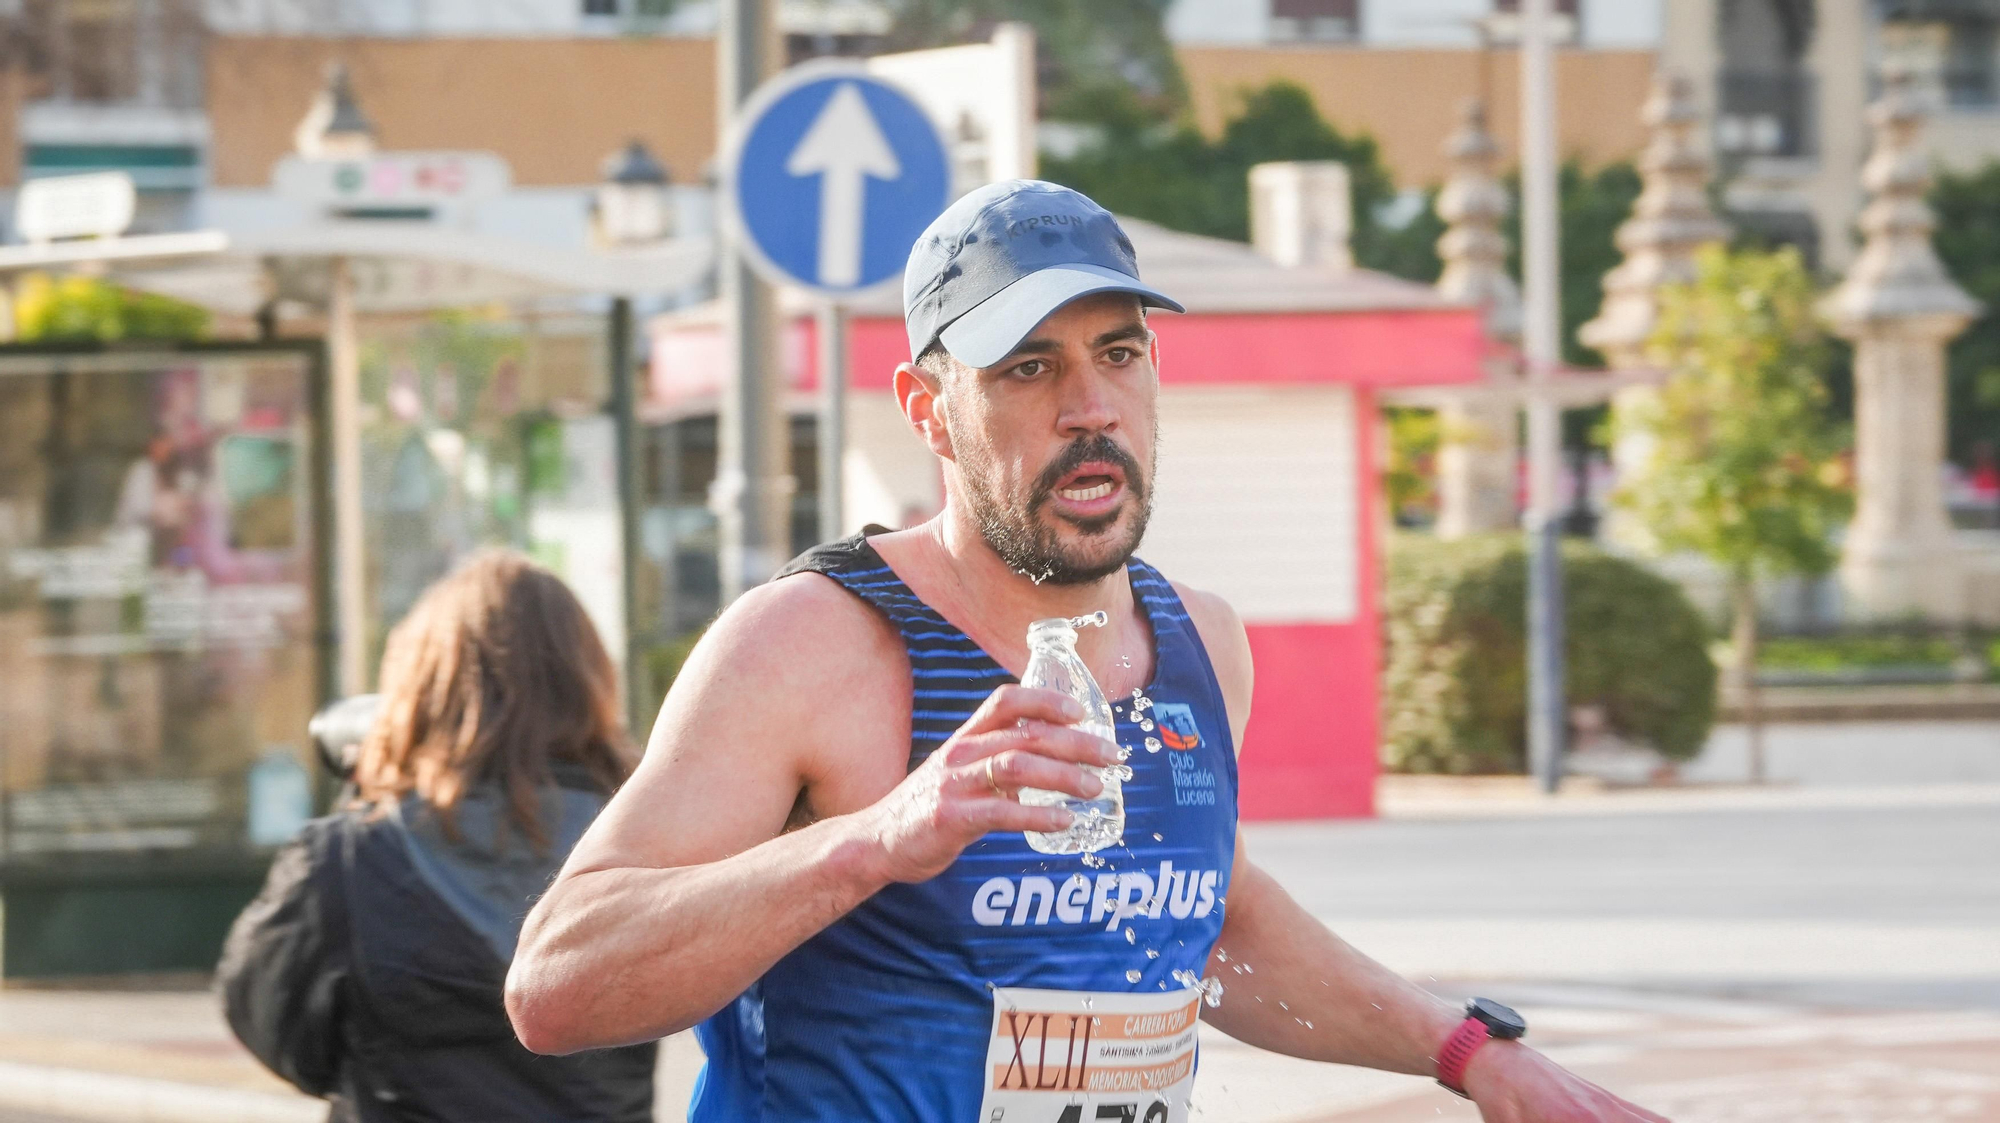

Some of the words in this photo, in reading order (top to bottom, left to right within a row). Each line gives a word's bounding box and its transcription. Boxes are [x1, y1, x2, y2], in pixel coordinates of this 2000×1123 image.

[1005, 214, 1083, 241] KIPRUN
[1168, 751, 1195, 770] Club
[1172, 768, 1216, 788] Maratón
[1175, 788, 1216, 806] Lucena
[971, 860, 1218, 932] enerplus
[1123, 1014, 1167, 1036] CARRERA
[998, 1013, 1093, 1090] XLII
[1089, 1070, 1143, 1092] MEMORIAL
